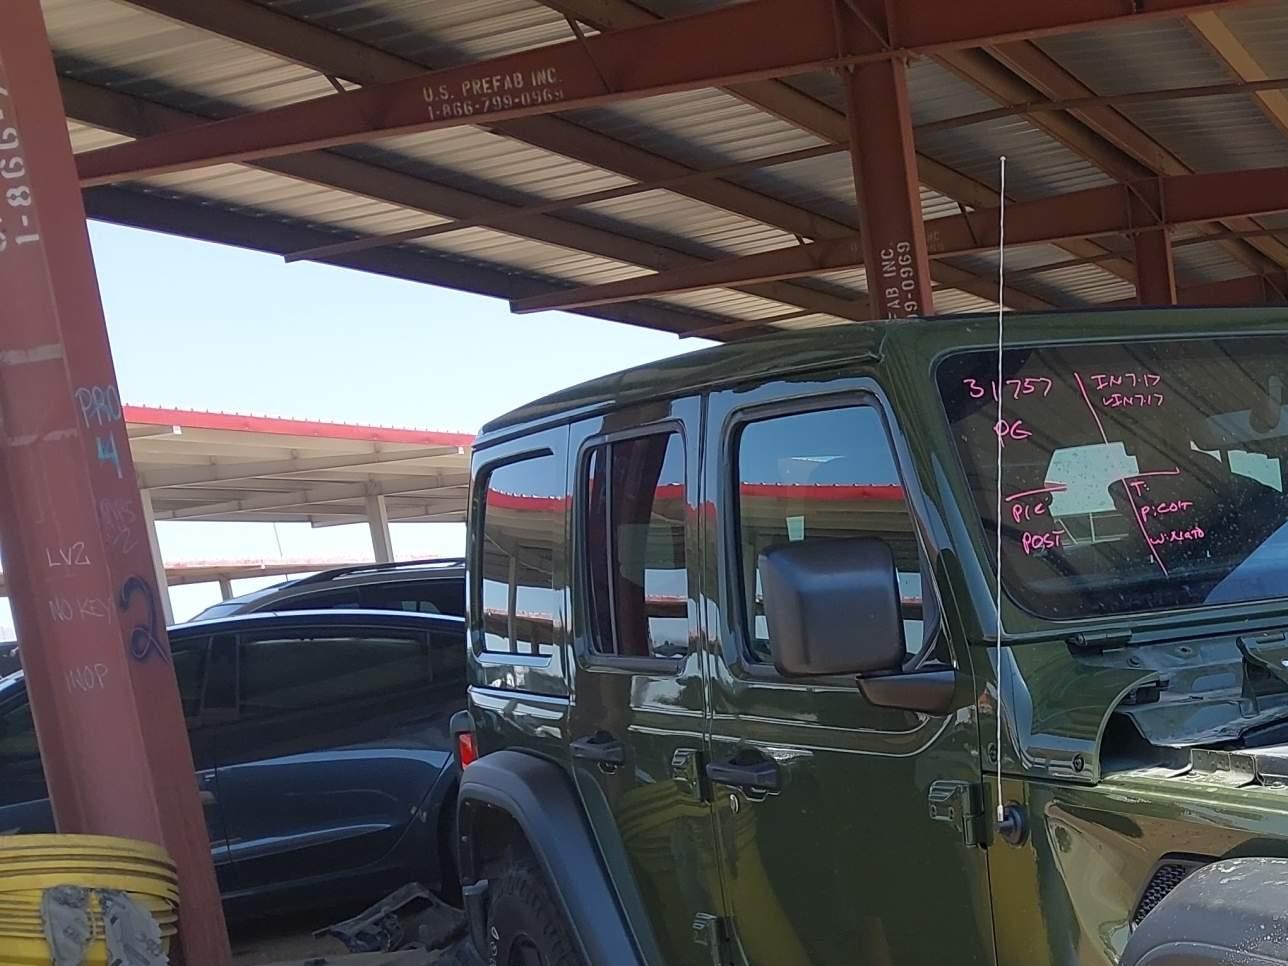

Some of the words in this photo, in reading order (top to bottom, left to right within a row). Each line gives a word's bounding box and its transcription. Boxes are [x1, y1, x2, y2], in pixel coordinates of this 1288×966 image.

[423, 85, 454, 102] U.S.
[461, 73, 524, 97] PREFAB
[96, 431, 123, 479] 4
